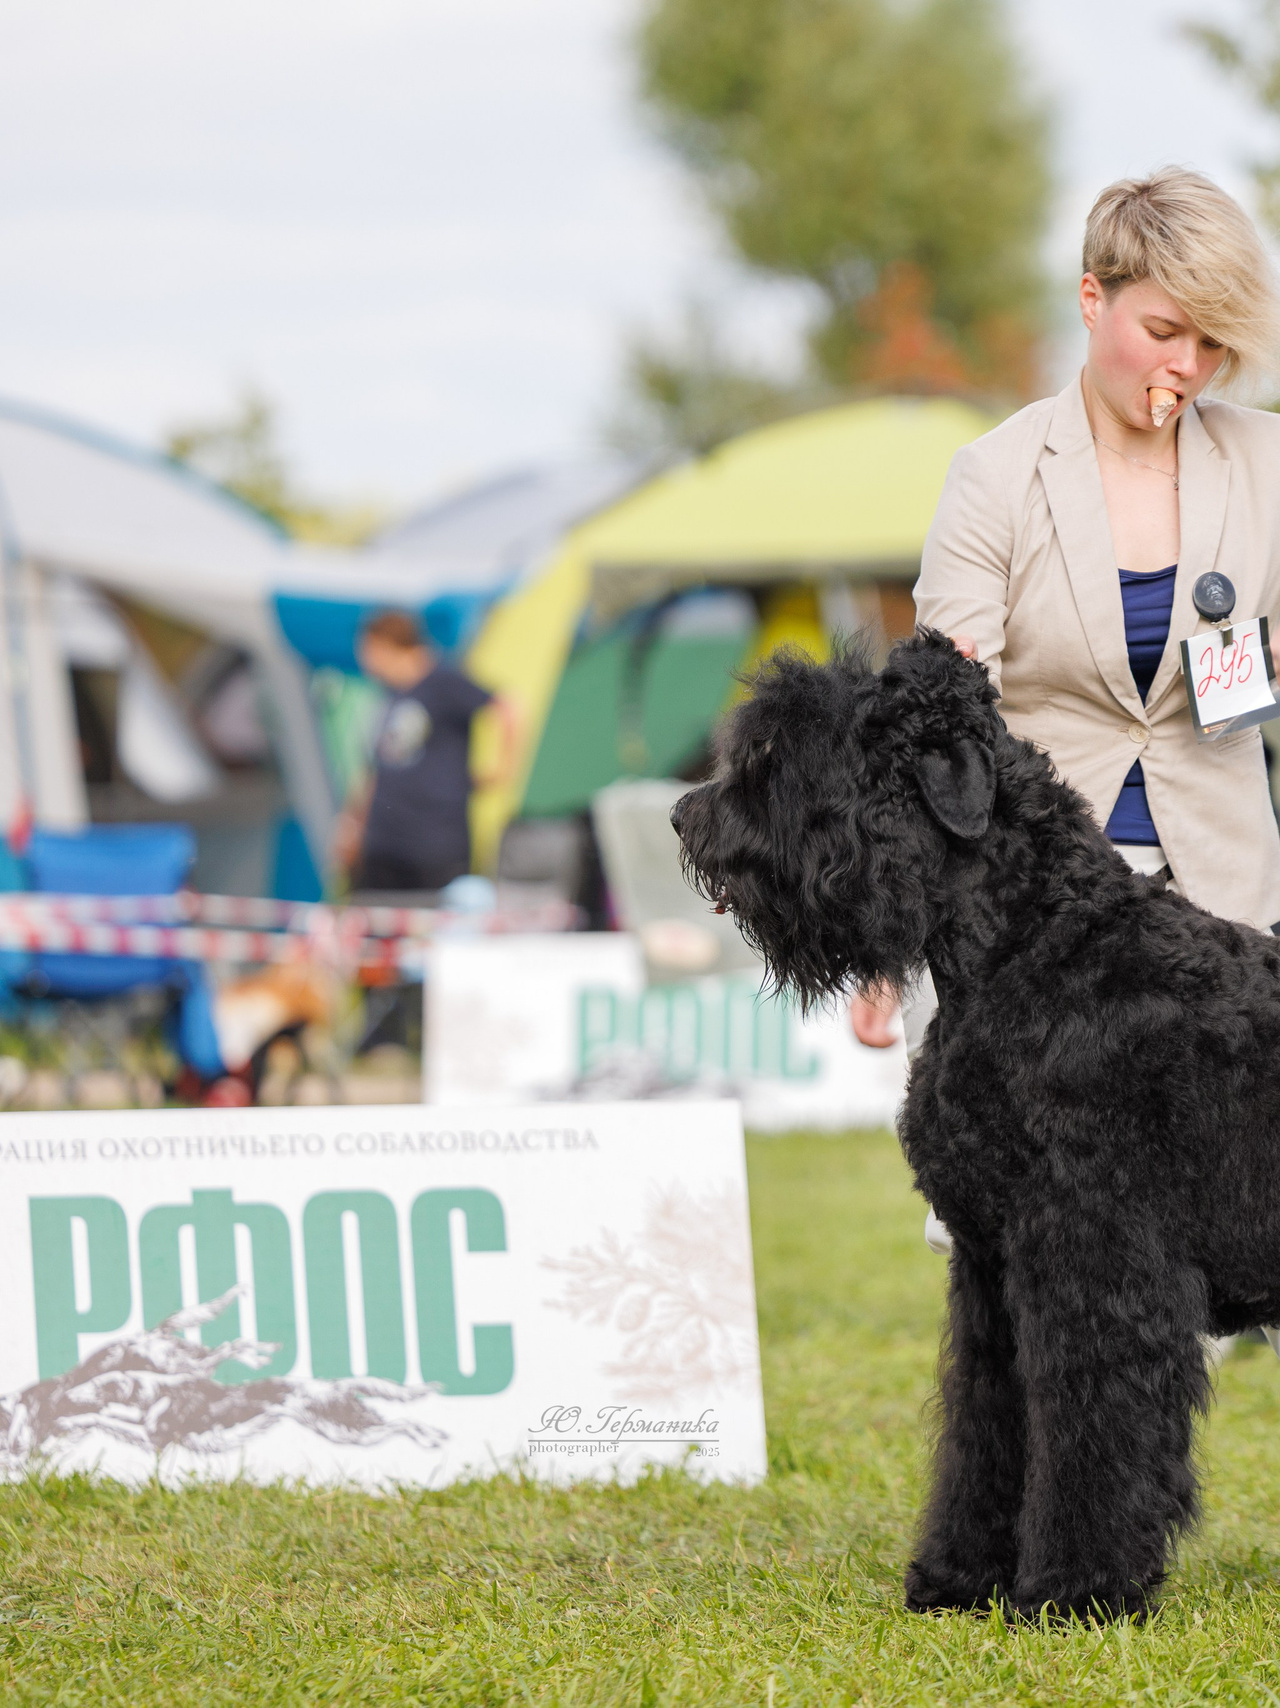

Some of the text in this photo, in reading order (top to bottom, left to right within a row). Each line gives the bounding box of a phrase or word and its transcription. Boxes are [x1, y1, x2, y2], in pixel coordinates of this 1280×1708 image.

[1197, 632, 1255, 698] 295
[0, 1127, 599, 1165] АЦИЯ ОХОТНИЧЬЕГО СОБАКОВОДСТВА
[29, 1187, 515, 1395] РФОС
